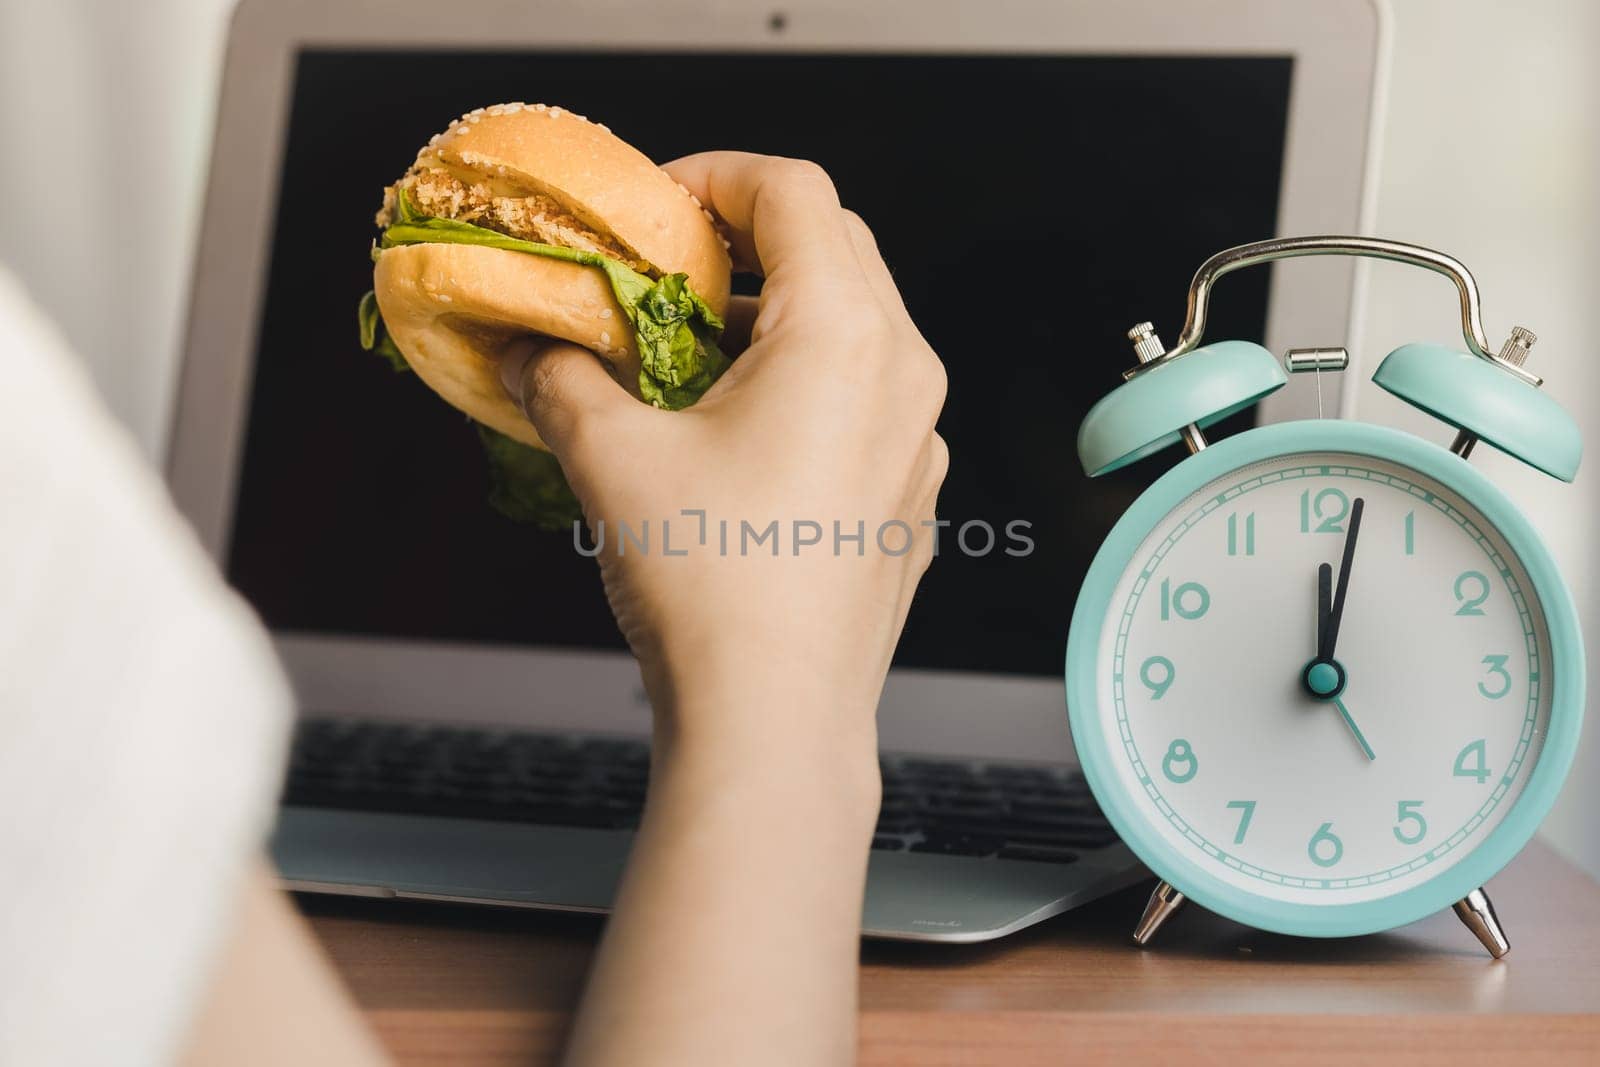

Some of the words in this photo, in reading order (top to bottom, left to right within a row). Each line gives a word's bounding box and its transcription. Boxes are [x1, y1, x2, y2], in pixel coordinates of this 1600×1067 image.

[1300, 487, 1349, 534] 12
[1405, 511, 1415, 556] 1
[1227, 512, 1255, 556] 11
[1160, 577, 1211, 621] 10
[1453, 570, 1491, 617] 2
[1139, 655, 1176, 701] 9
[1477, 654, 1513, 700] 3
[1161, 738, 1199, 785] 8
[1453, 739, 1492, 785] 4
[1226, 800, 1257, 846] 7
[1307, 822, 1344, 868] 6
[1392, 800, 1428, 846] 5
